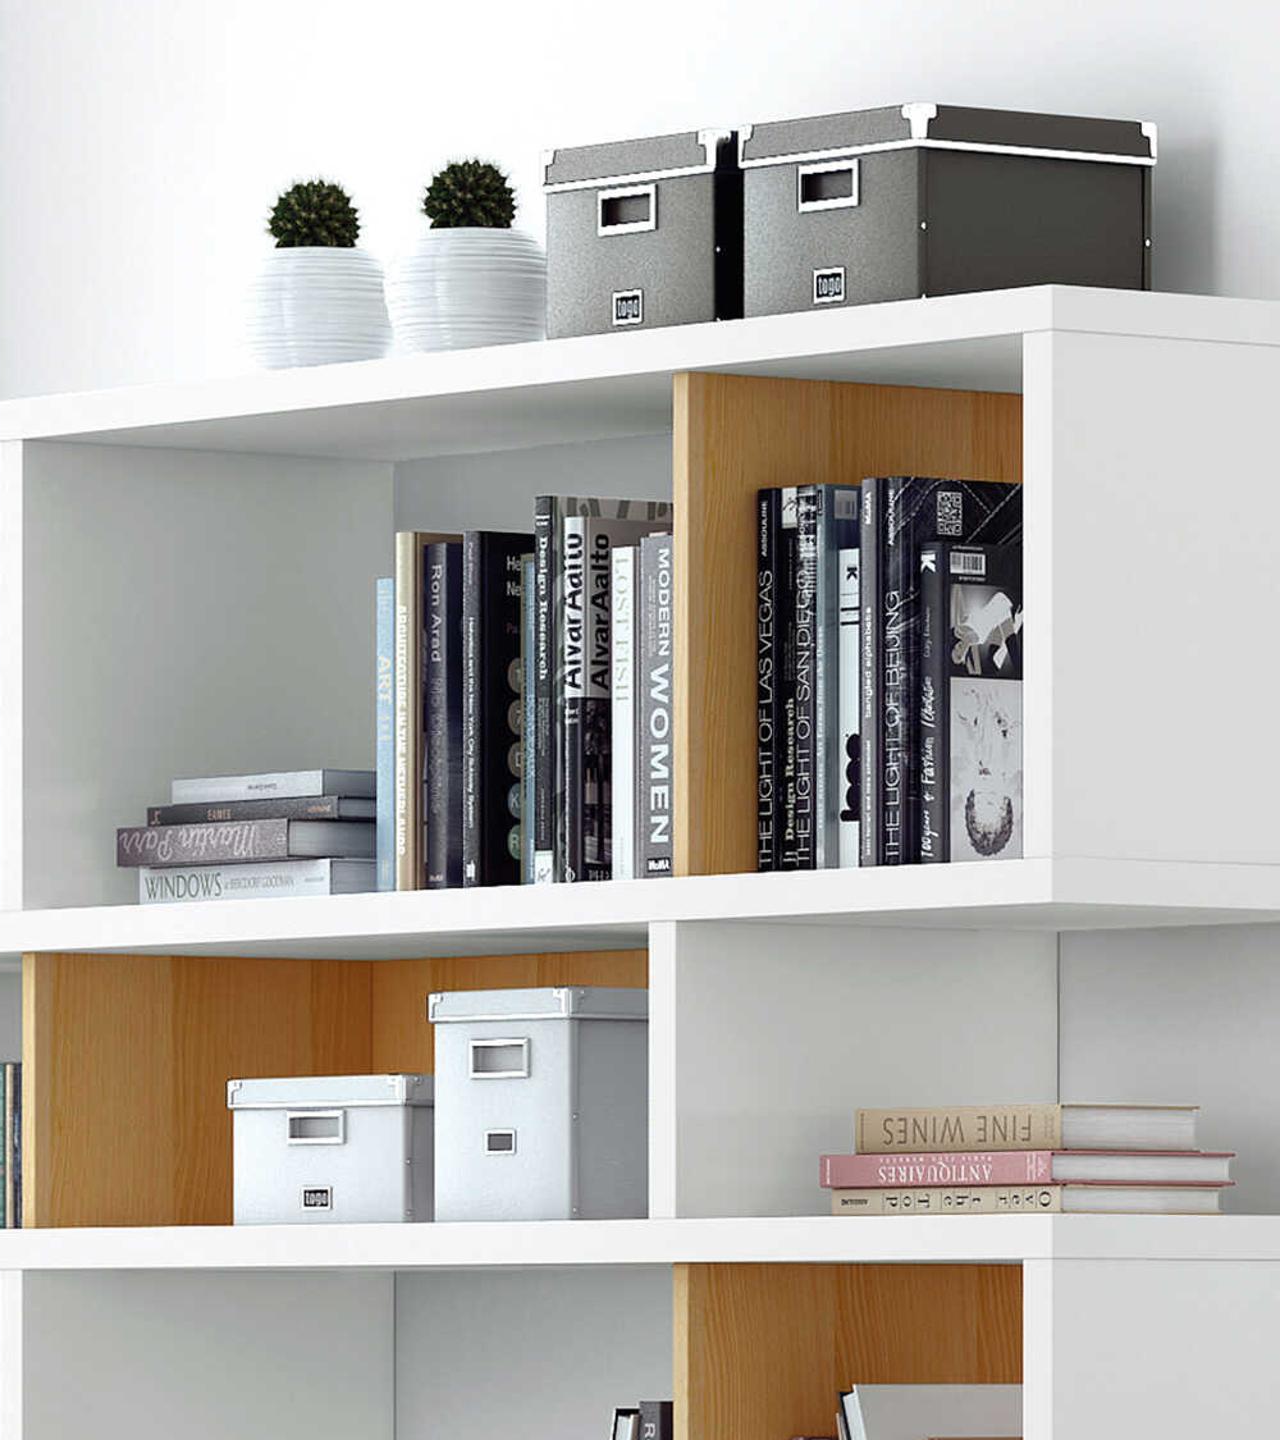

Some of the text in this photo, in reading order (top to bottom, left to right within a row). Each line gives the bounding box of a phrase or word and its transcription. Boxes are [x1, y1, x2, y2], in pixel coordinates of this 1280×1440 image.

[818, 277, 841, 296] togo
[431, 565, 443, 662] Ron Arad
[537, 536, 549, 680] Design Research
[591, 534, 609, 690] AlvarAalto
[658, 548, 670, 656] MODERN
[650, 664, 669, 844] WOMEN
[759, 570, 773, 868] THE LIGHT OF LAS VEGAS
[797, 570, 810, 866] THE LIGHT OF SAN DIEGO
[885, 591, 900, 862] THE LIGHT OF BEIJING
[785, 698, 796, 841] Design Research
[119, 825, 255, 861] Martin Parr
[144, 872, 222, 900] WINDOWS
[879, 1163, 993, 1183] ANTIQUAIRES
[883, 1116, 966, 1146] WINES
[976, 1114, 1033, 1143] FINE
[886, 1193, 931, 1209] Top
